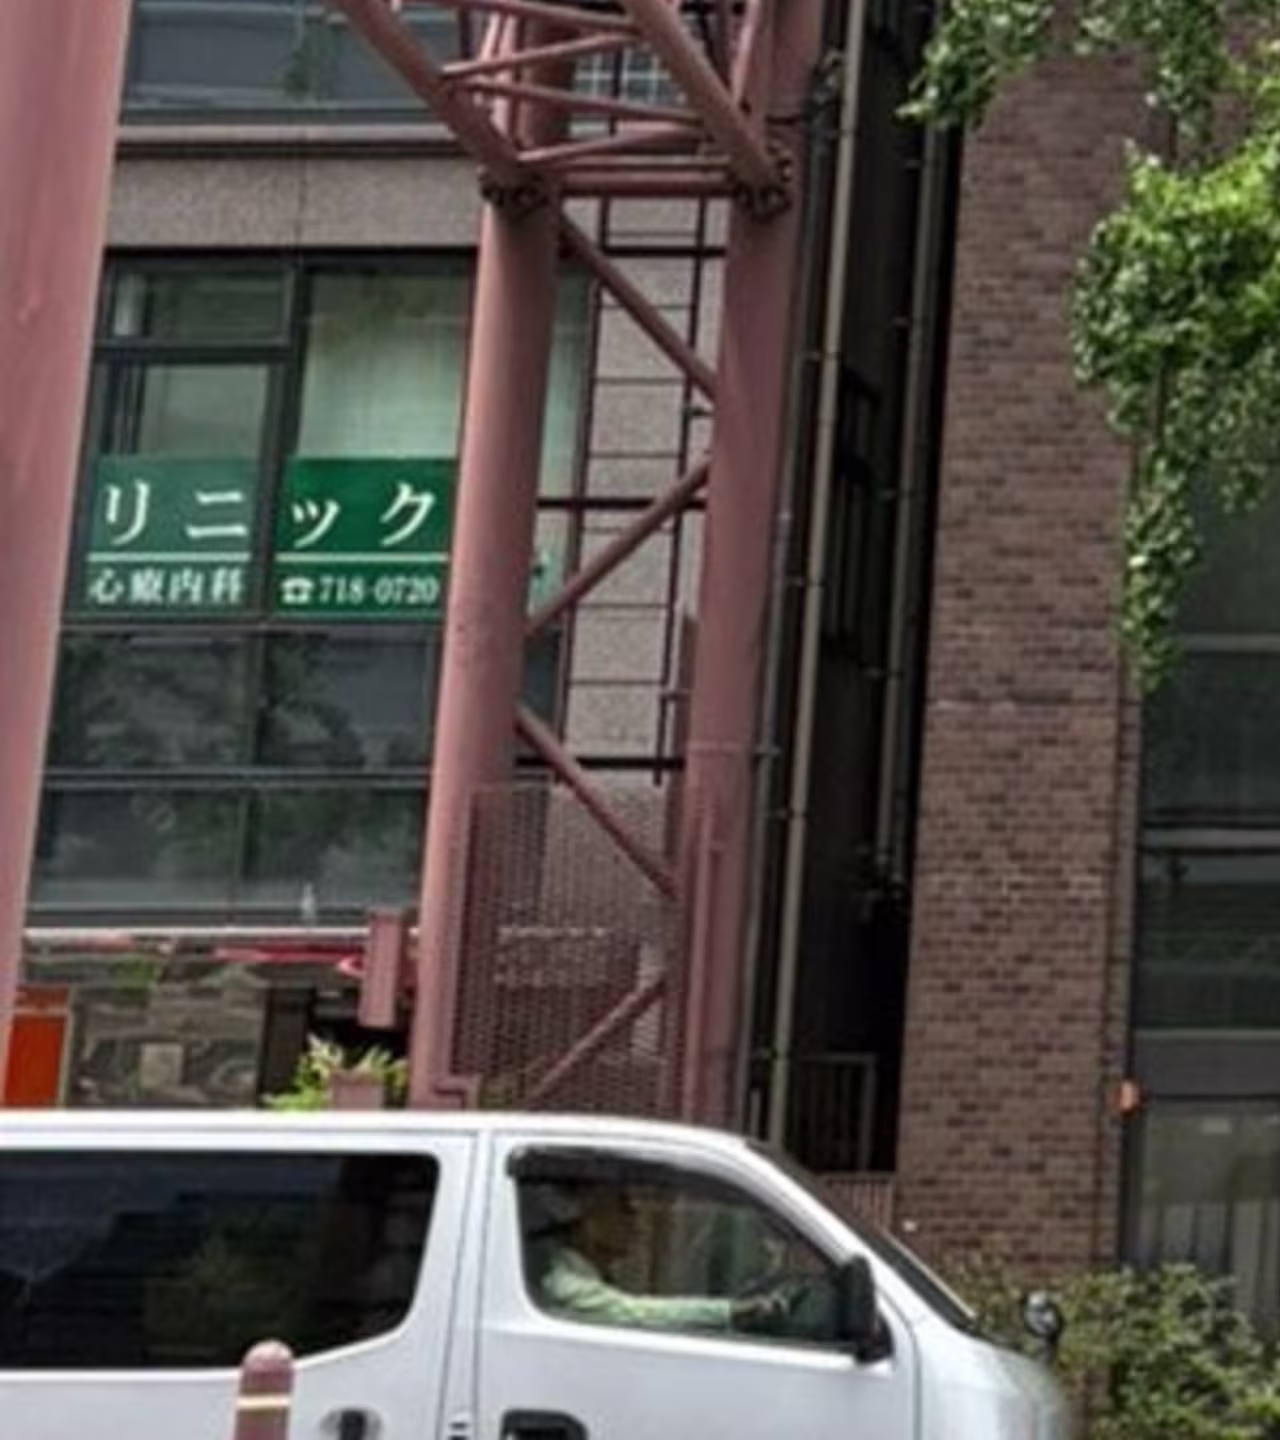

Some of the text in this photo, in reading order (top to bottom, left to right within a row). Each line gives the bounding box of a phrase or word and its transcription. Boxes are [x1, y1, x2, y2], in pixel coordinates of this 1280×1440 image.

[104, 478, 438, 549] リニック
[88, 566, 244, 606] 心療内科
